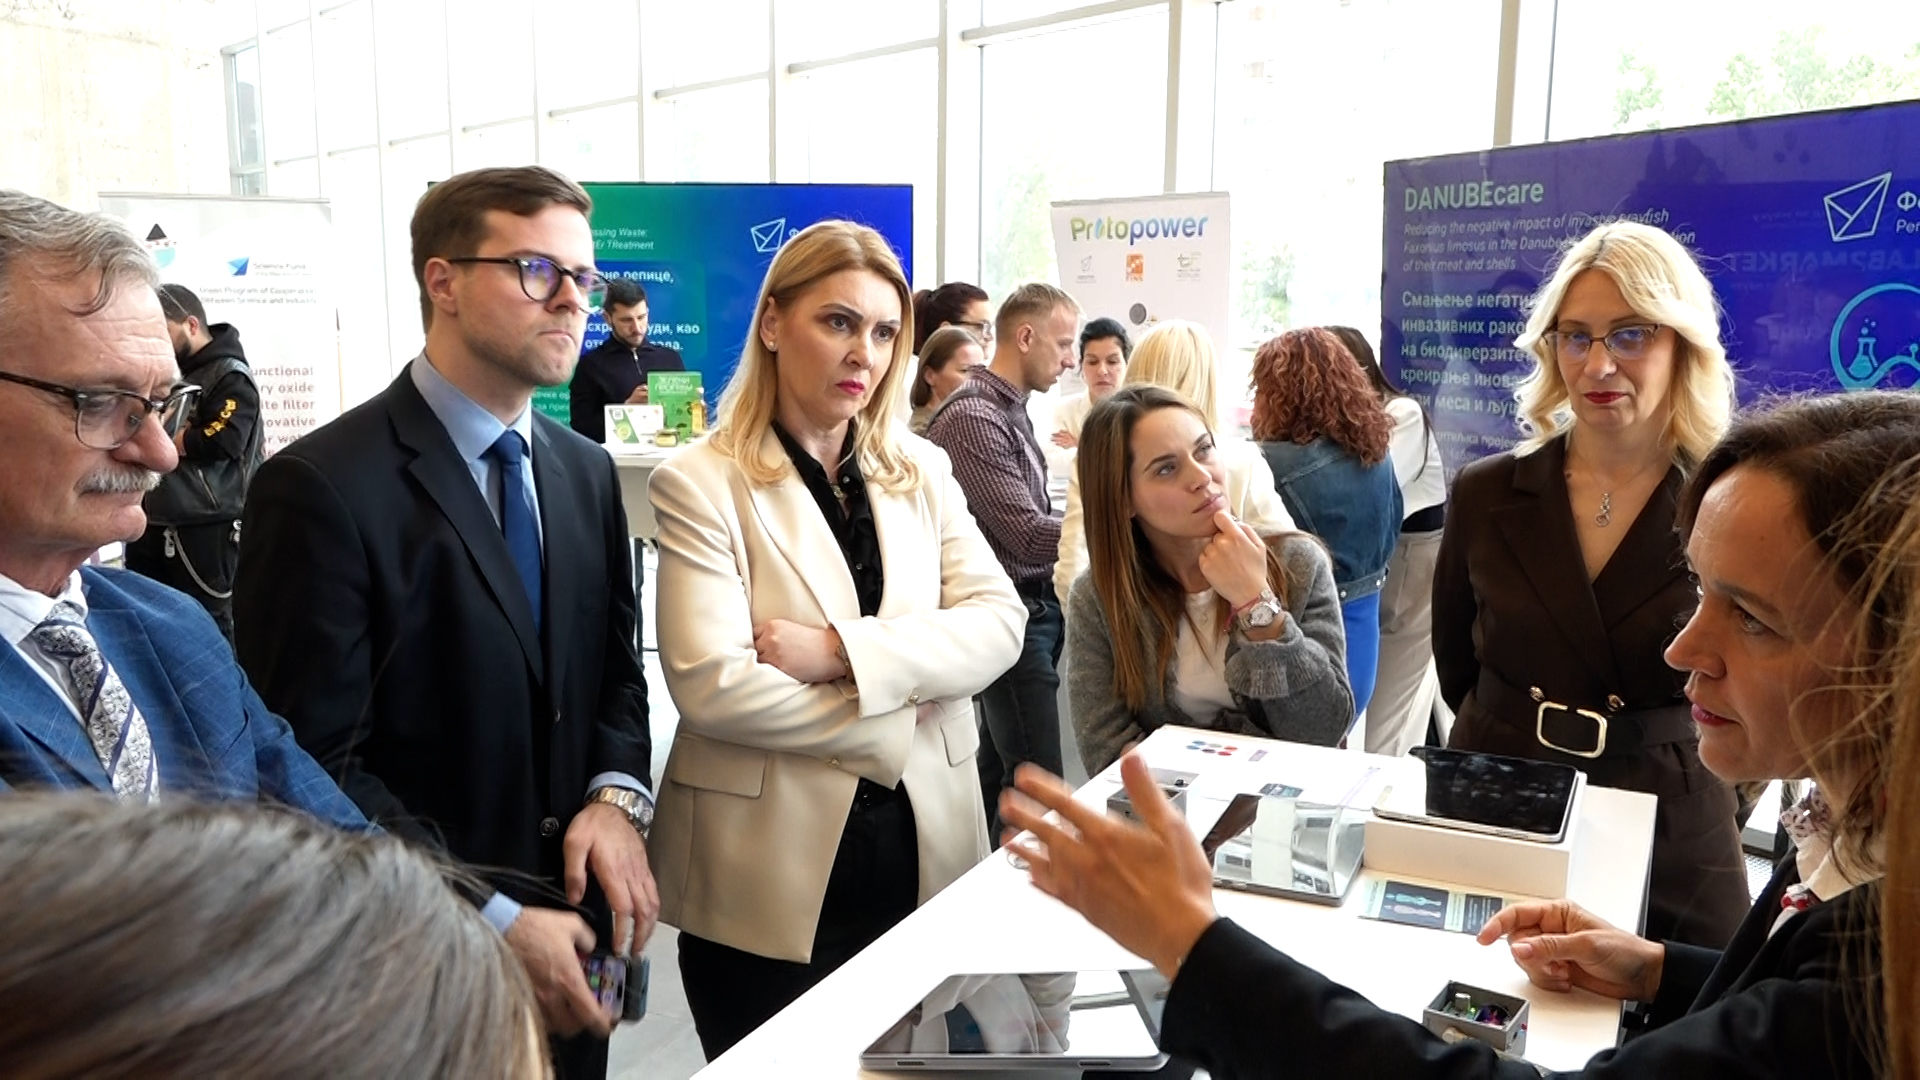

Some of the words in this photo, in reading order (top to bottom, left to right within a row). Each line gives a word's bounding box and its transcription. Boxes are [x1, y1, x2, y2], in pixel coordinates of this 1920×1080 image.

[1404, 181, 1544, 212] DANUBEcare
[1070, 216, 1209, 246] Protopower
[1404, 222, 1447, 237] Reducing
[1450, 220, 1465, 234] the
[1467, 219, 1511, 235] negative
[1513, 217, 1550, 233] impact
[1554, 213, 1566, 227] of
[607, 240, 654, 250] TReatment
[1488, 237, 1498, 250] in
[1501, 237, 1517, 250] the
[1402, 259, 1414, 273] of
[1415, 258, 1435, 272] their
[1437, 259, 1463, 272] meat
[1465, 258, 1483, 271] and
[1486, 255, 1516, 271] shells
[1402, 290, 1473, 308] Смањење
[676, 323, 701, 334] као
[1401, 317, 1485, 333] инвазивних
[1488, 320, 1528, 338] рако
[1401, 345, 1417, 357] на
[252, 366, 314, 376] unctional
[1400, 369, 1471, 386] креирање
[278, 382, 315, 394] oxide
[283, 399, 316, 410] filter
[1435, 397, 1471, 412] меса
[1474, 400, 1483, 412] и
